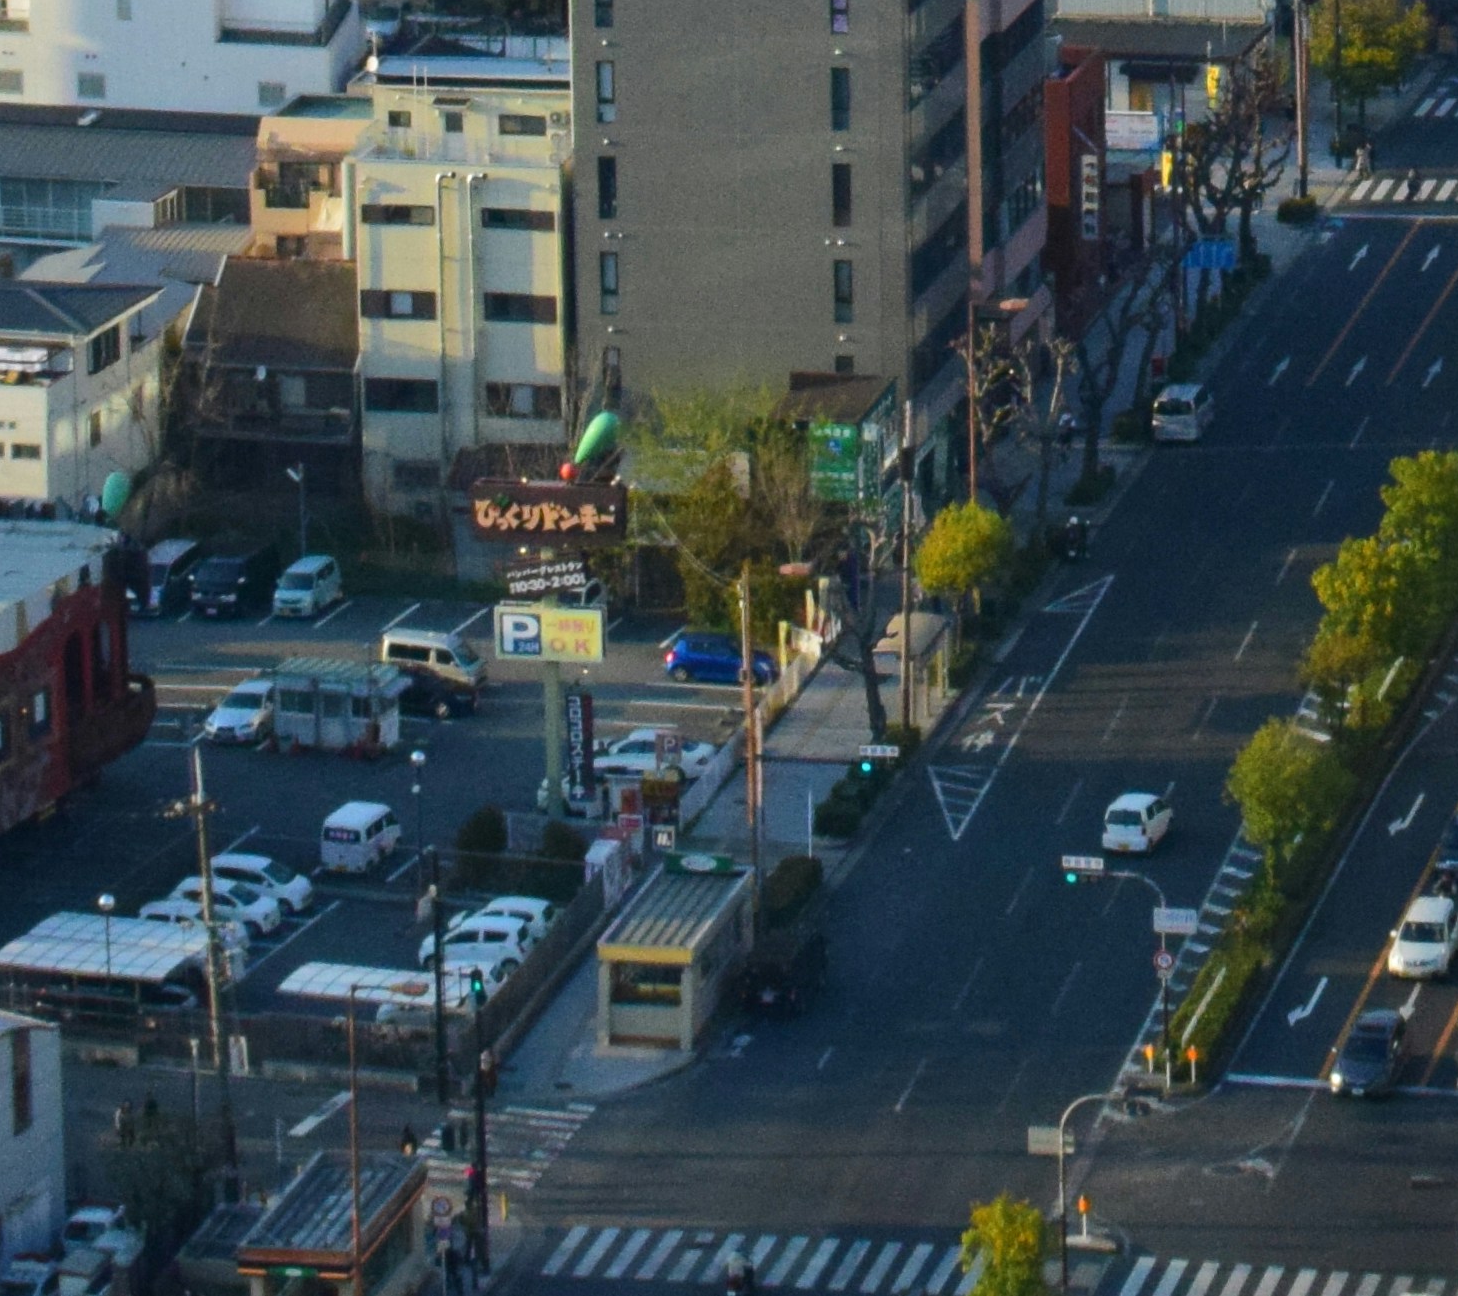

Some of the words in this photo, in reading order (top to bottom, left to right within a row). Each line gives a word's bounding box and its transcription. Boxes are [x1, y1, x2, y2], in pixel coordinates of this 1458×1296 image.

[474, 498, 616, 533] びっくりドンキー
[503, 612, 539, 651] P
